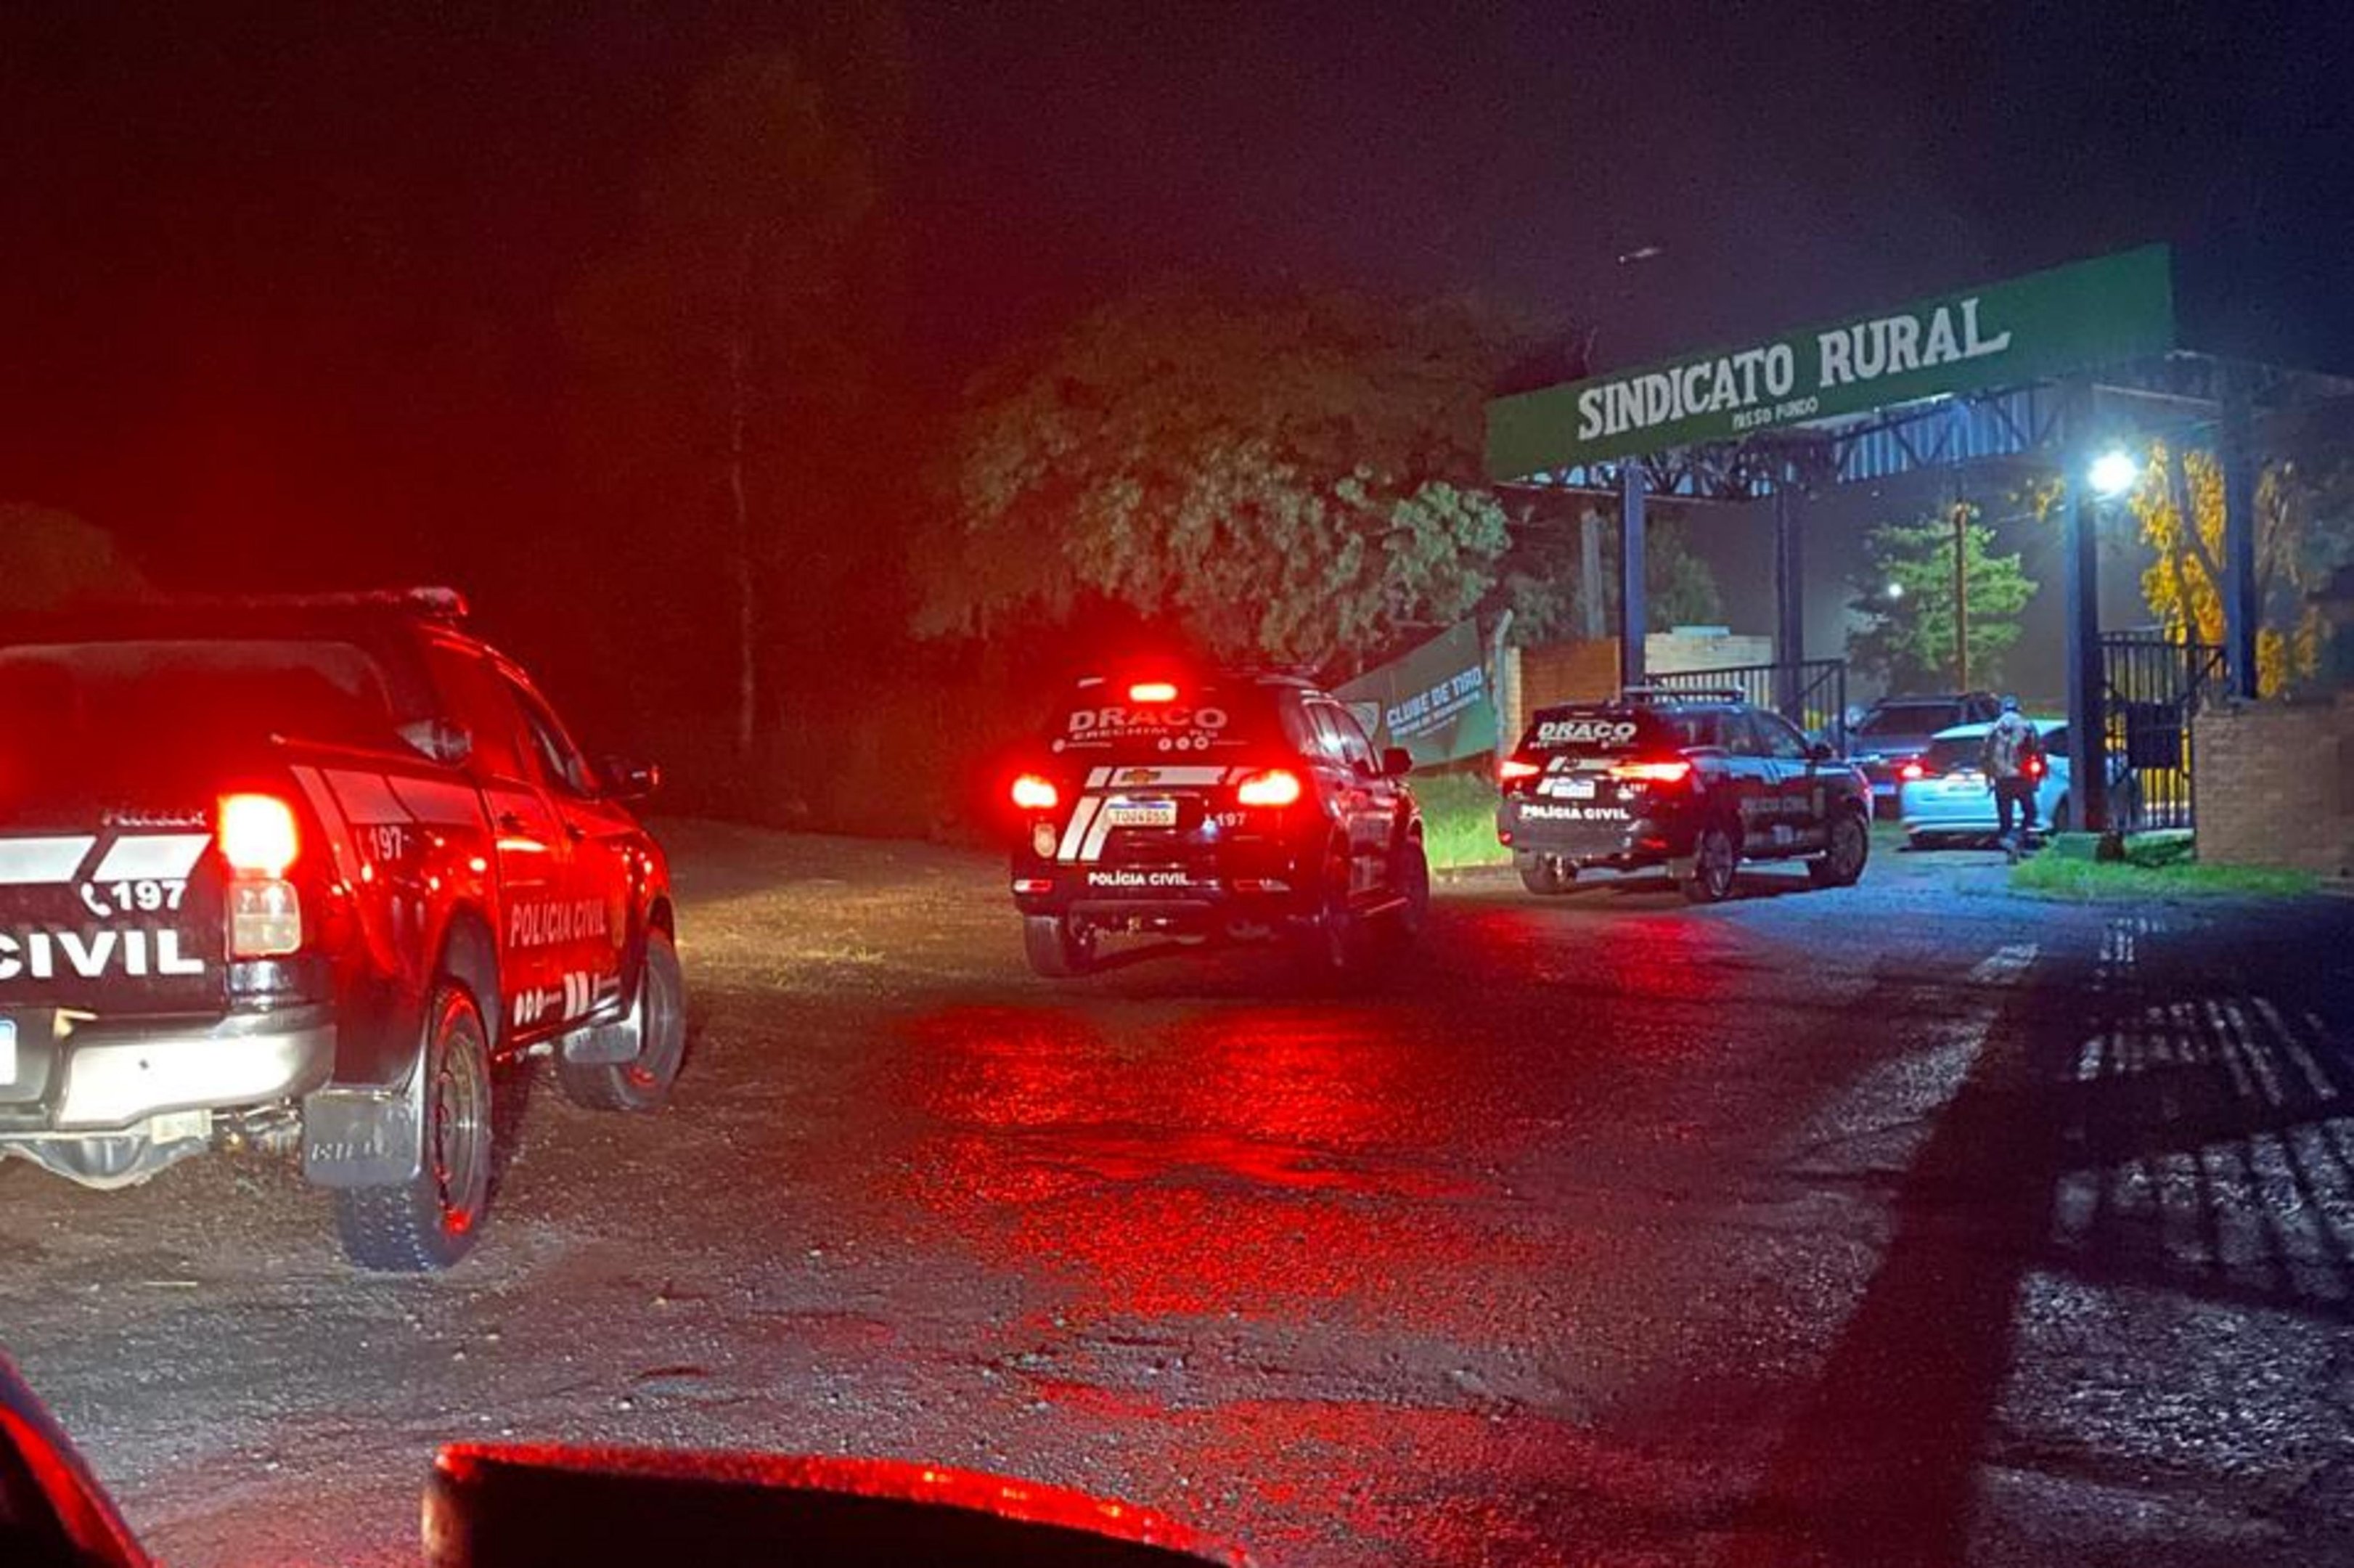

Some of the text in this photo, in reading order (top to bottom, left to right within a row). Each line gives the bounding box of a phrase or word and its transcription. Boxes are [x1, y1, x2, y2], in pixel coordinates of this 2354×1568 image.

[1578, 298, 2011, 441] SINDICATO RURAL
[1387, 693, 1430, 728] CLUBE
[1431, 682, 1450, 706] DE
[1450, 666, 1482, 696] TIRO
[1069, 707, 1227, 732] DRACO
[1537, 722, 1637, 739] DRACO
[1216, 812, 1246, 827] 197
[1583, 807, 1631, 820] CIVIL
[368, 825, 402, 860] 197
[1088, 870, 1188, 886] POLÍCIA CIVIL
[112, 880, 187, 910] 197
[573, 899, 606, 939] CIVIL
